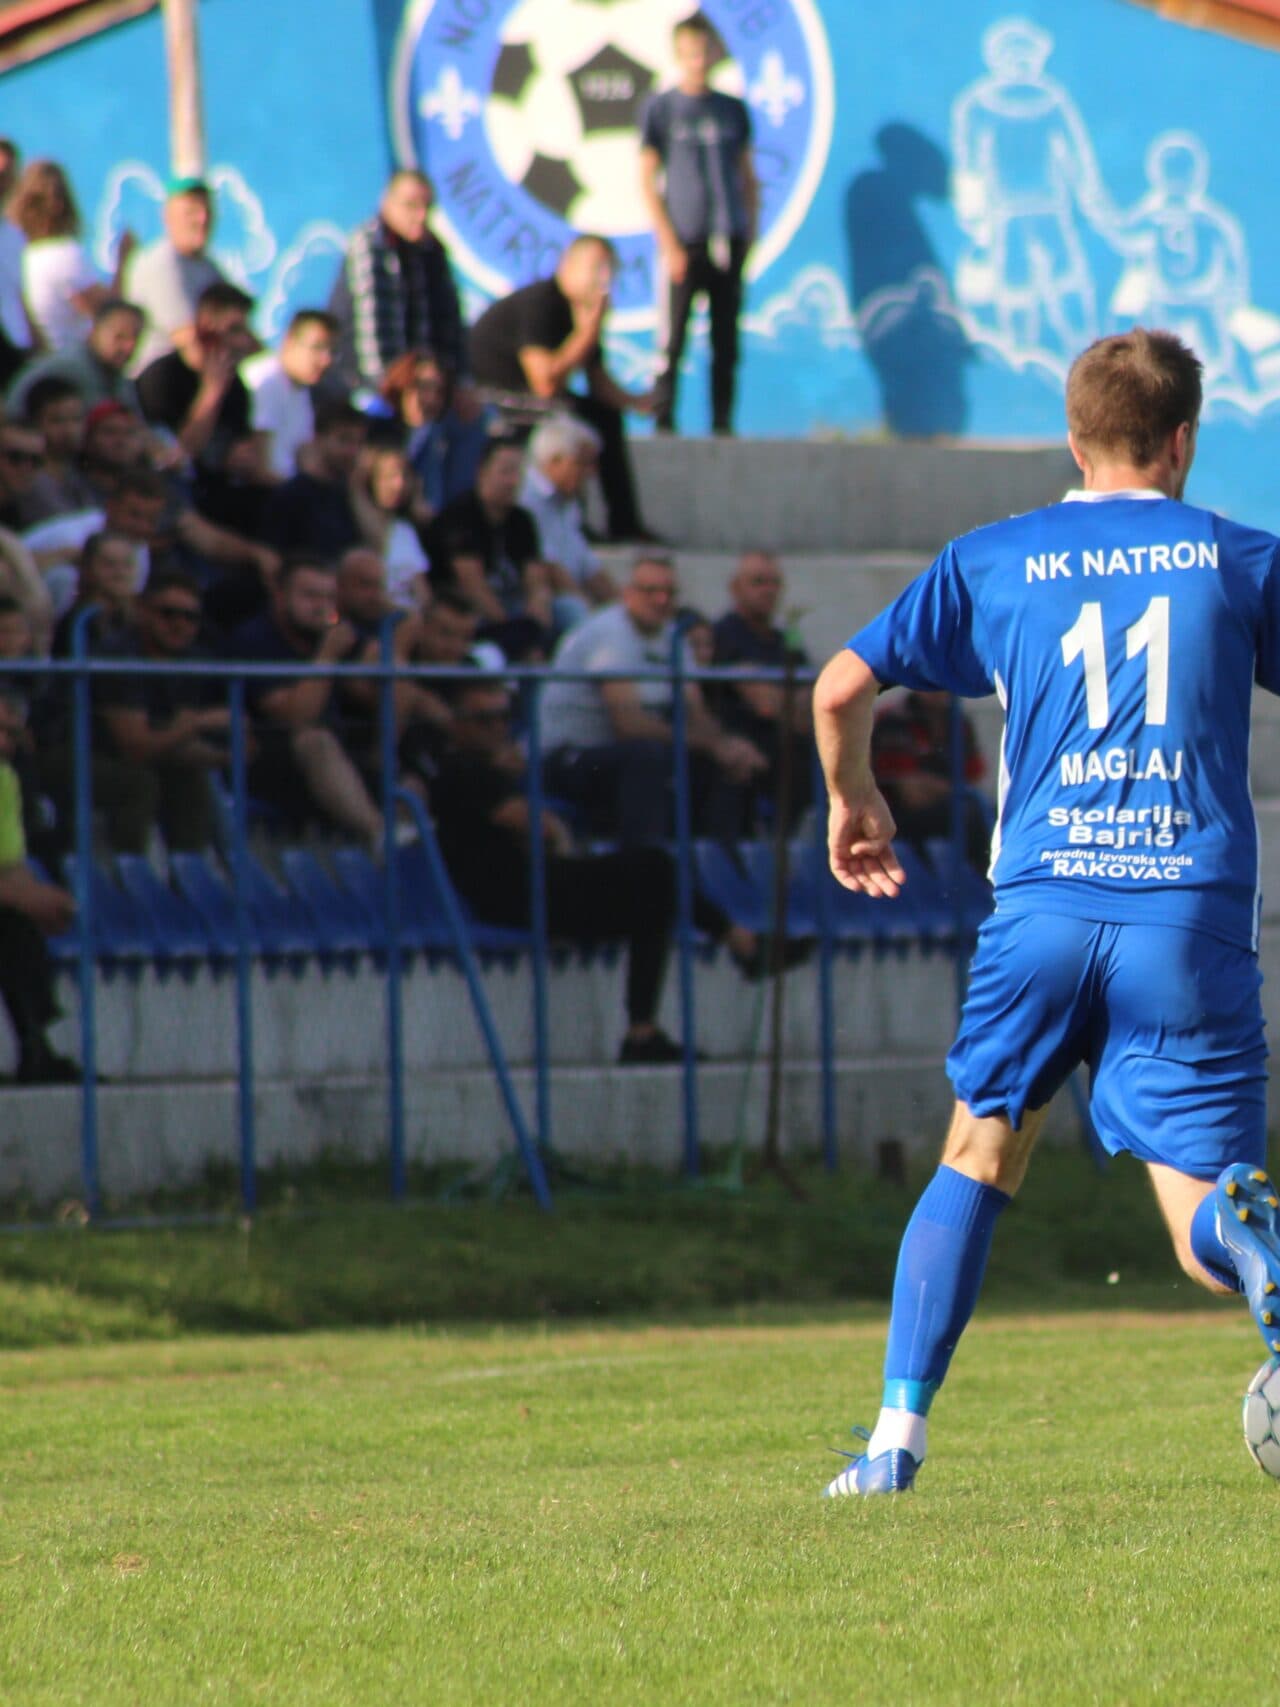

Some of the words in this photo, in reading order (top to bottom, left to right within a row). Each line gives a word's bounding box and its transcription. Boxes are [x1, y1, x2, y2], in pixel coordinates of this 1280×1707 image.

[1025, 551, 1072, 583] NK
[1082, 541, 1218, 577] NATRON
[1061, 596, 1170, 730] 11
[1060, 747, 1183, 787] MAGLAJ
[1047, 805, 1192, 828] Stolarija
[1068, 826, 1175, 849] Bajrić
[1053, 859, 1181, 880] RAKOVAC
[1159, 854, 1193, 867] voda
